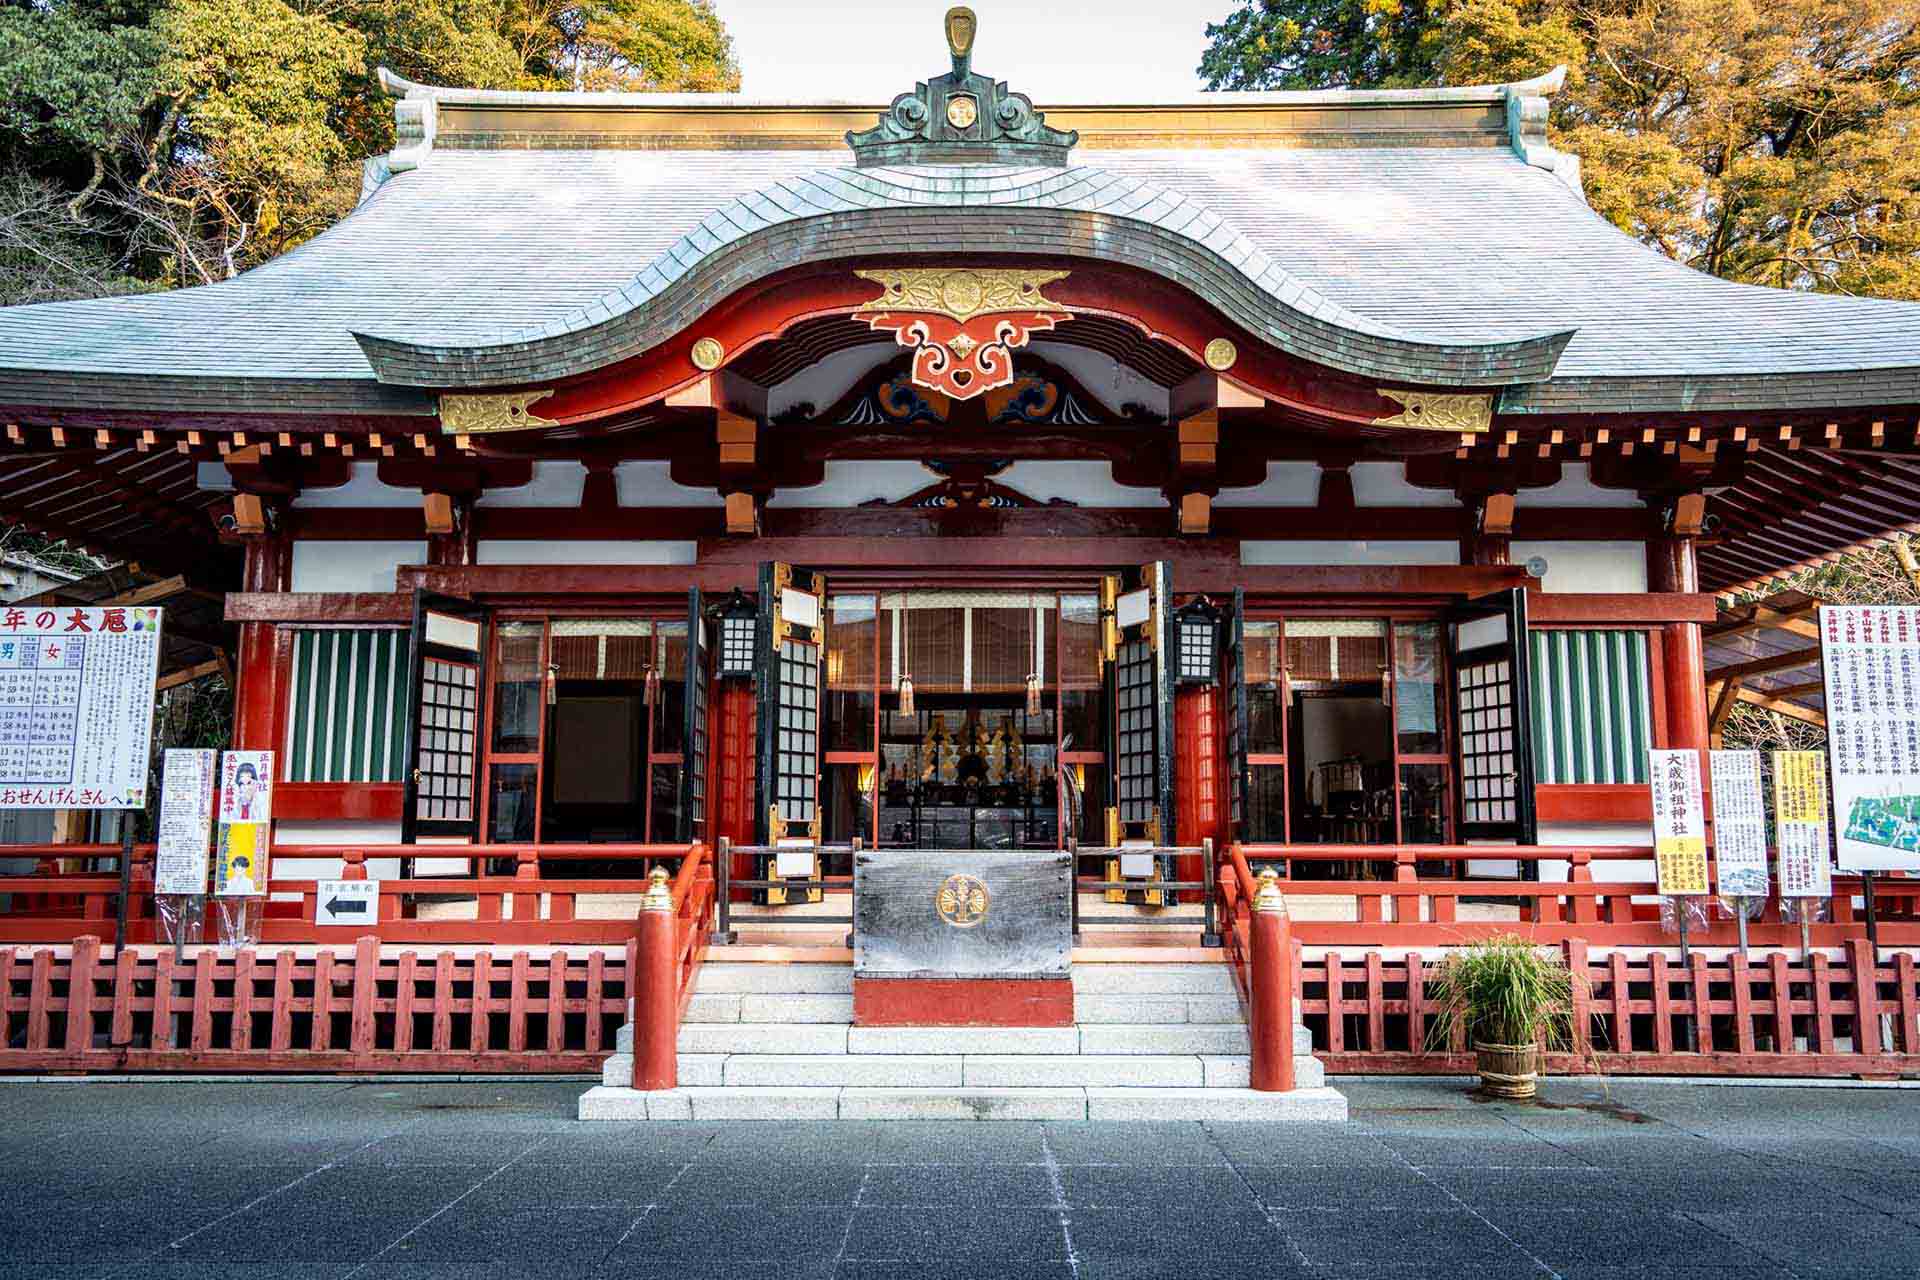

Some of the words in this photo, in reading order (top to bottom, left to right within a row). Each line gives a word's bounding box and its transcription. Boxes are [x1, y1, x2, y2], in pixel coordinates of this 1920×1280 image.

[2, 608, 128, 632] 年の大厄
[1, 642, 14, 660] 男
[44, 643, 61, 660] 女
[1, 788, 123, 805] おせんげんさんへ
[1666, 753, 1689, 836] 大歳御祖神社
